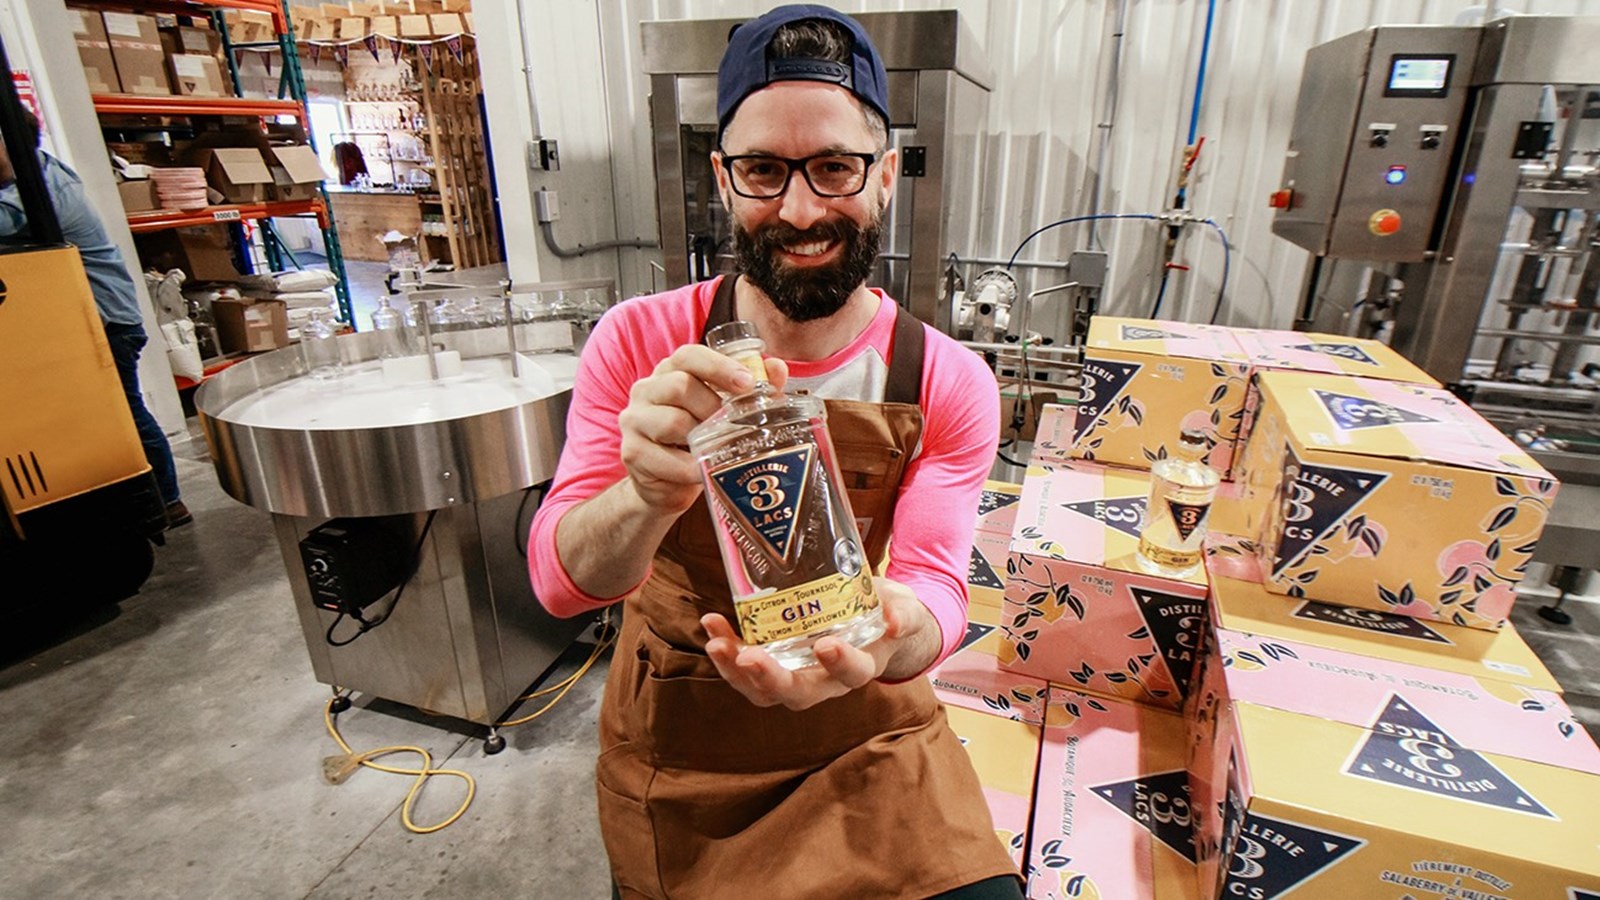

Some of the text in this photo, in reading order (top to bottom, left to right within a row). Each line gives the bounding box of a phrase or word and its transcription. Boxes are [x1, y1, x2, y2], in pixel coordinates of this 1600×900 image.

[1083, 364, 1115, 382] LERIE
[1079, 405, 1098, 416] CS
[736, 463, 789, 487] DISTILLERIE
[1296, 472, 1345, 497] LERIE
[747, 474, 786, 512] 3
[753, 506, 793, 529] LACS
[1105, 506, 1137, 522] 3
[1180, 510, 1198, 525] 3
[1285, 526, 1313, 540] CS
[761, 582, 838, 610] CITRON TOURNESOL
[782, 599, 822, 622] GIN
[767, 609, 847, 639] LEMON SUNFLOWER
[1167, 648, 1191, 661] LA
[932, 678, 979, 694] AUDACIEUX
[1378, 722, 1448, 745] LACS
[1065, 736, 1079, 775] BOTANIQUE
[1398, 738, 1462, 777] 3
[1382, 758, 1497, 793] DISTILLERIE
[1061, 789, 1076, 836] AUDACIEUX
[1135, 782, 1150, 822] LACS
[1150, 792, 1191, 827] 3
[1241, 823, 1305, 857] LERIE
[1228, 881, 1264, 900] CS
[1381, 871, 1444, 893] SALABERRY
